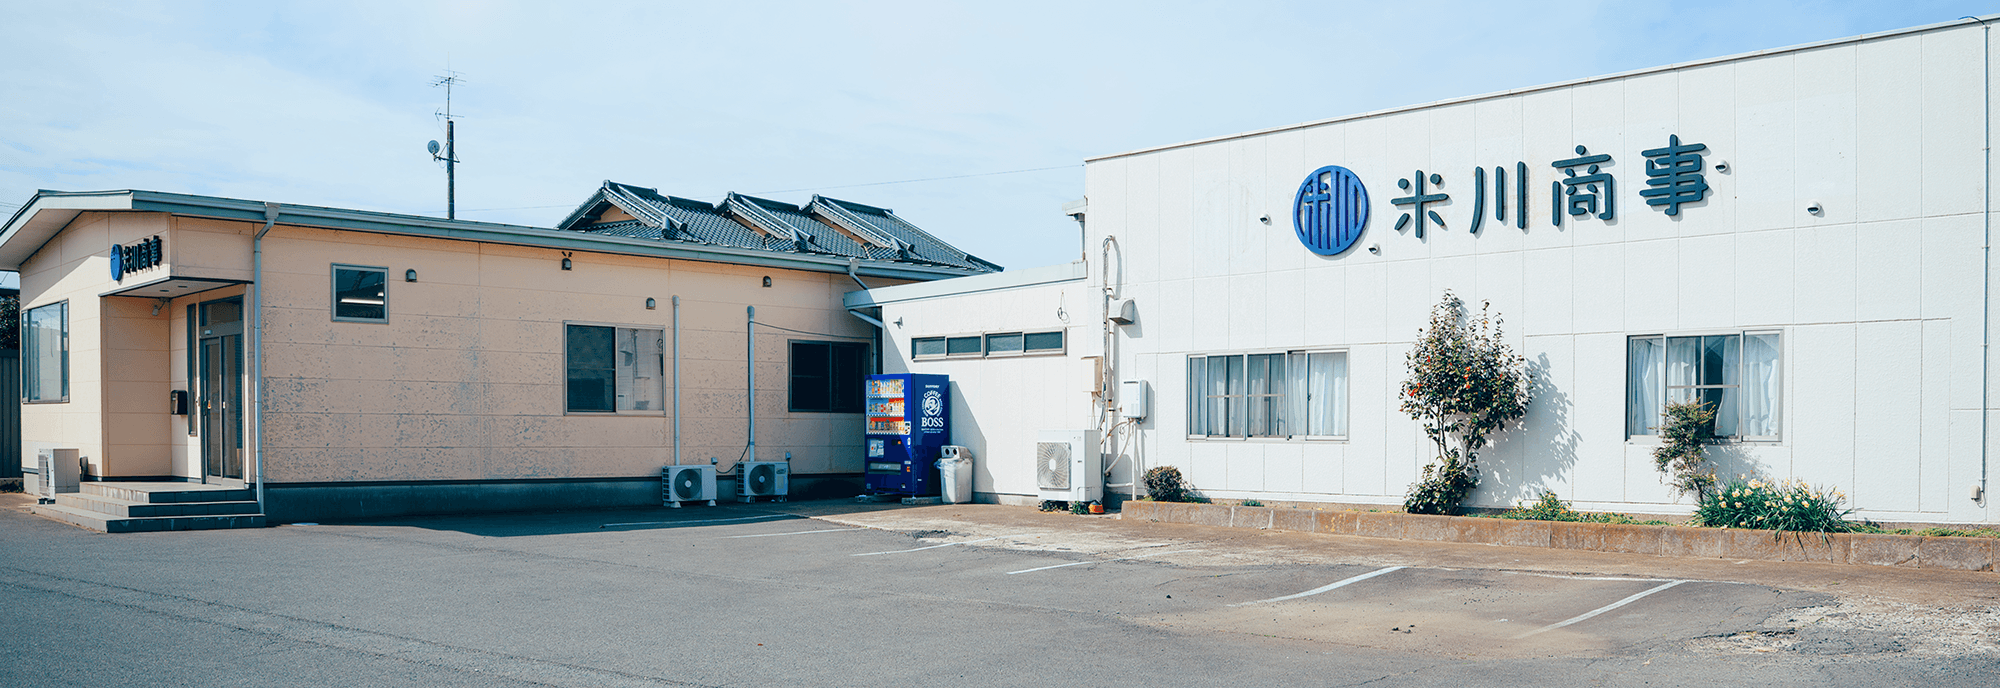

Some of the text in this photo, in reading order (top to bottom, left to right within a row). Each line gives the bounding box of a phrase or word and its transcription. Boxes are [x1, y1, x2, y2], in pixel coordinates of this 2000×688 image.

[1391, 134, 1708, 238] 米川商事
[921, 417, 943, 427] BOSS
